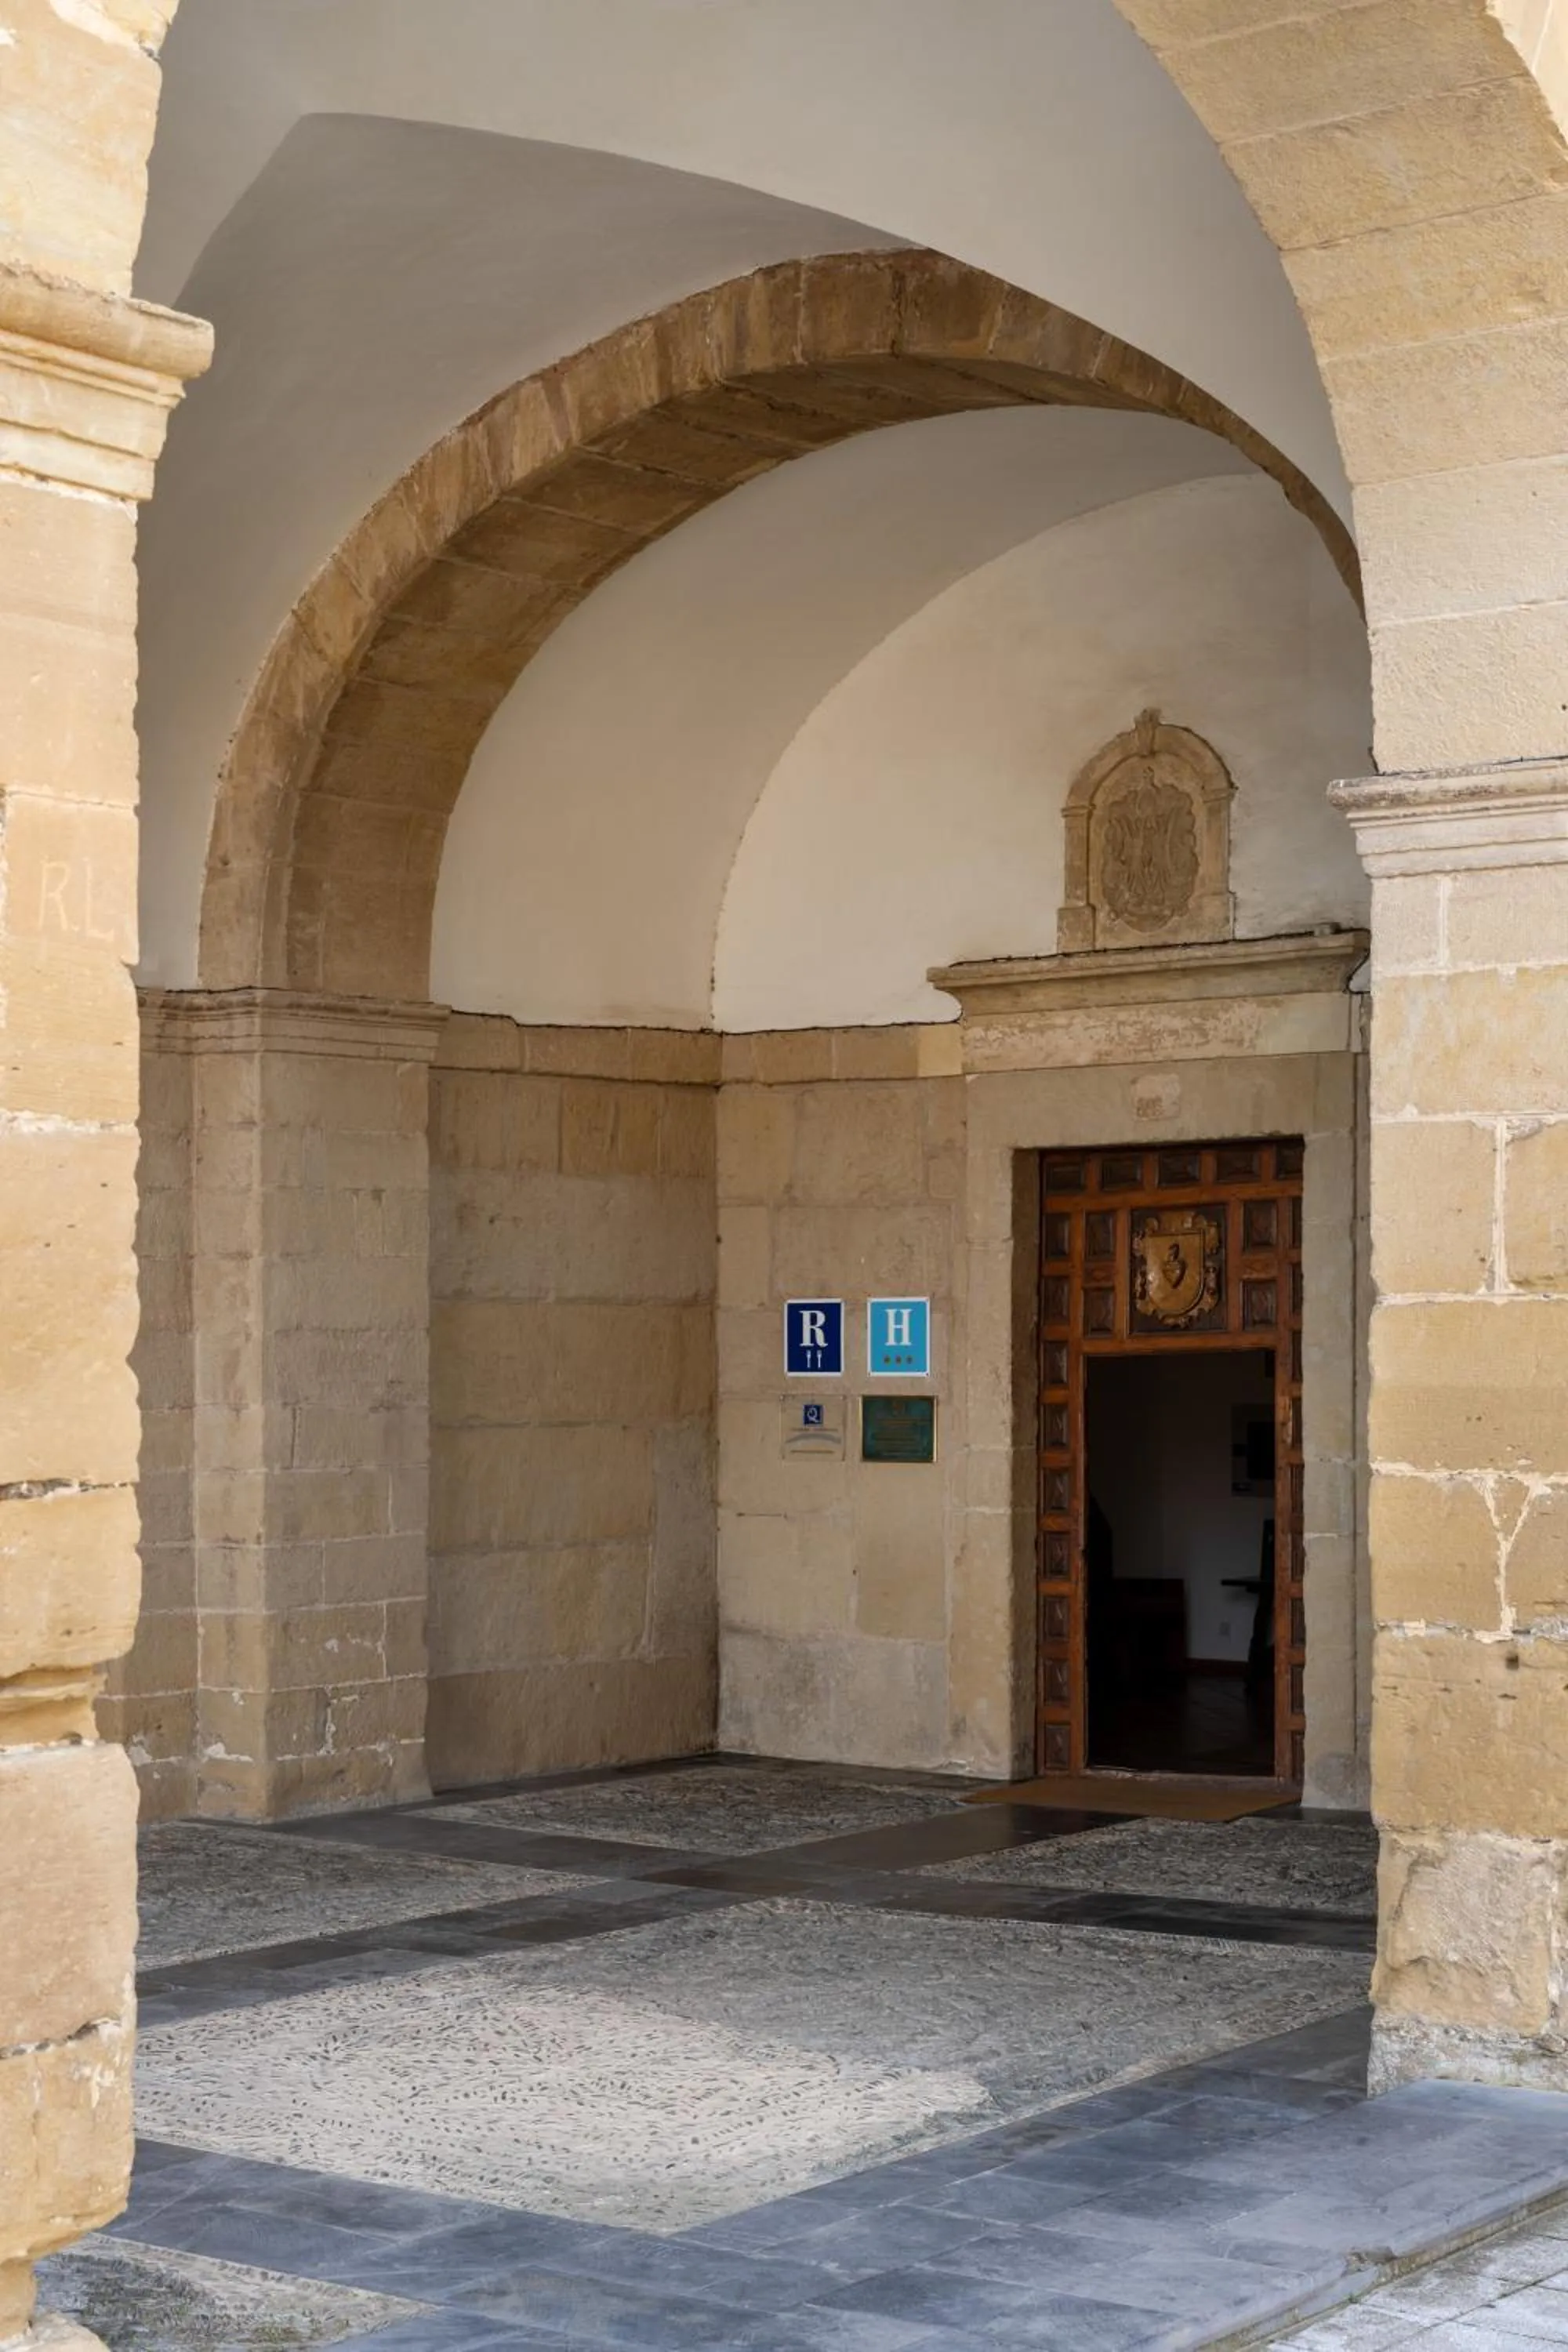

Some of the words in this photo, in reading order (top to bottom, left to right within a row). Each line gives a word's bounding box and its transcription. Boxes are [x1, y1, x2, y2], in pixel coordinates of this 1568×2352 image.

[800, 1310, 828, 1347] R
[885, 1308, 913, 1346] H
[807, 1407, 819, 1423] Q
